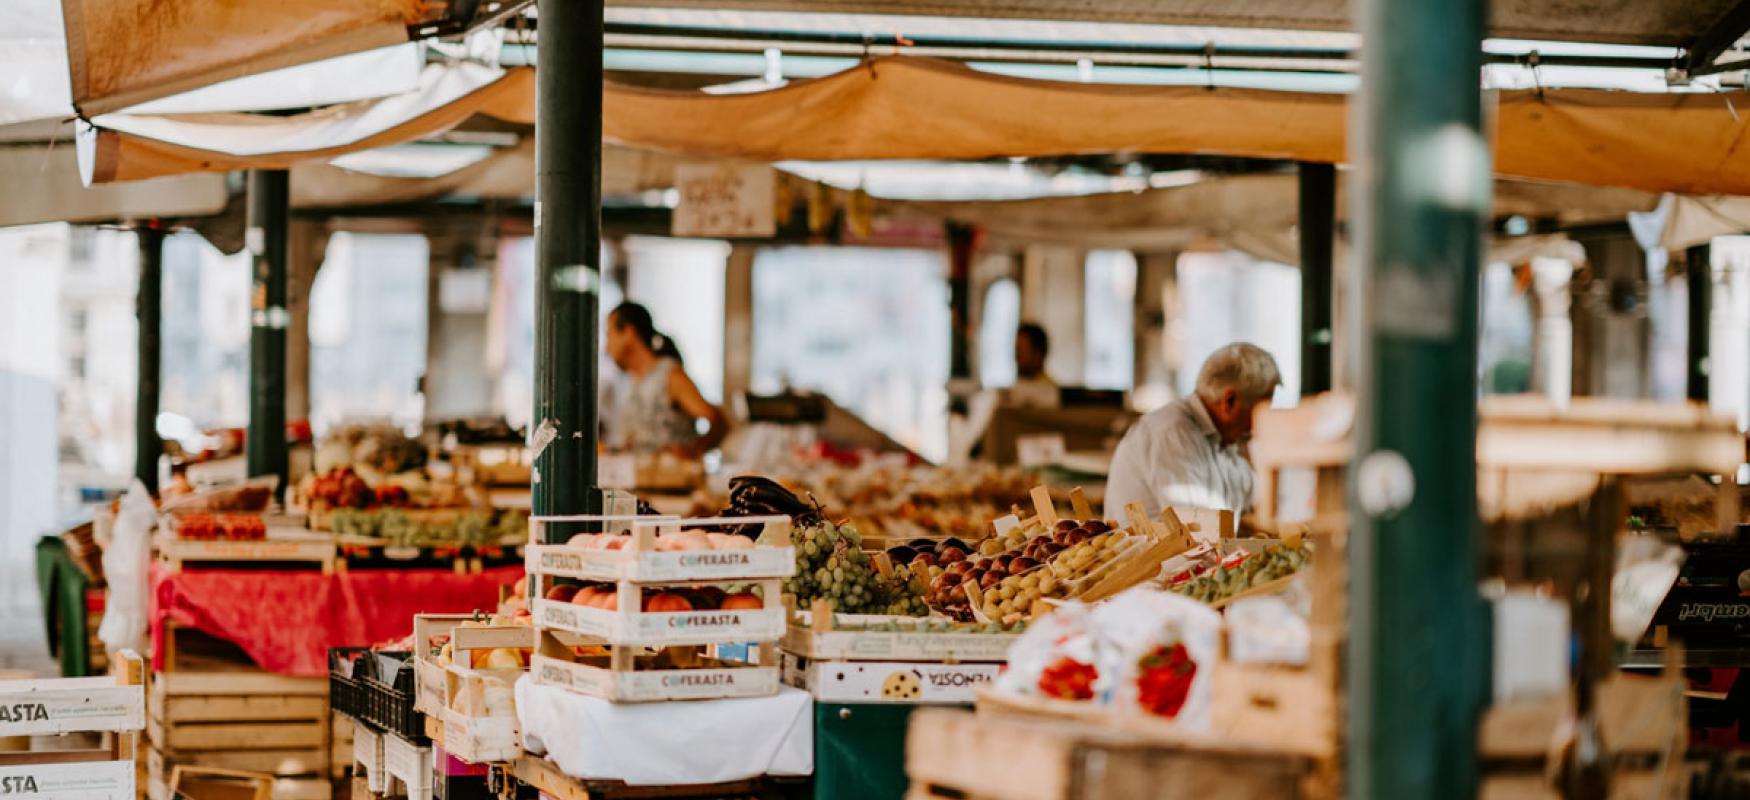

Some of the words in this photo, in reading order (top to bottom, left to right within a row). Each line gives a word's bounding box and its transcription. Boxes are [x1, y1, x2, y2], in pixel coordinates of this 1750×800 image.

[679, 553, 750, 567] COFERASTA
[668, 614, 741, 628] COFERASTA
[661, 674, 734, 688] COFERASTA
[0, 704, 49, 722] ASTA
[2, 775, 39, 794] STA
